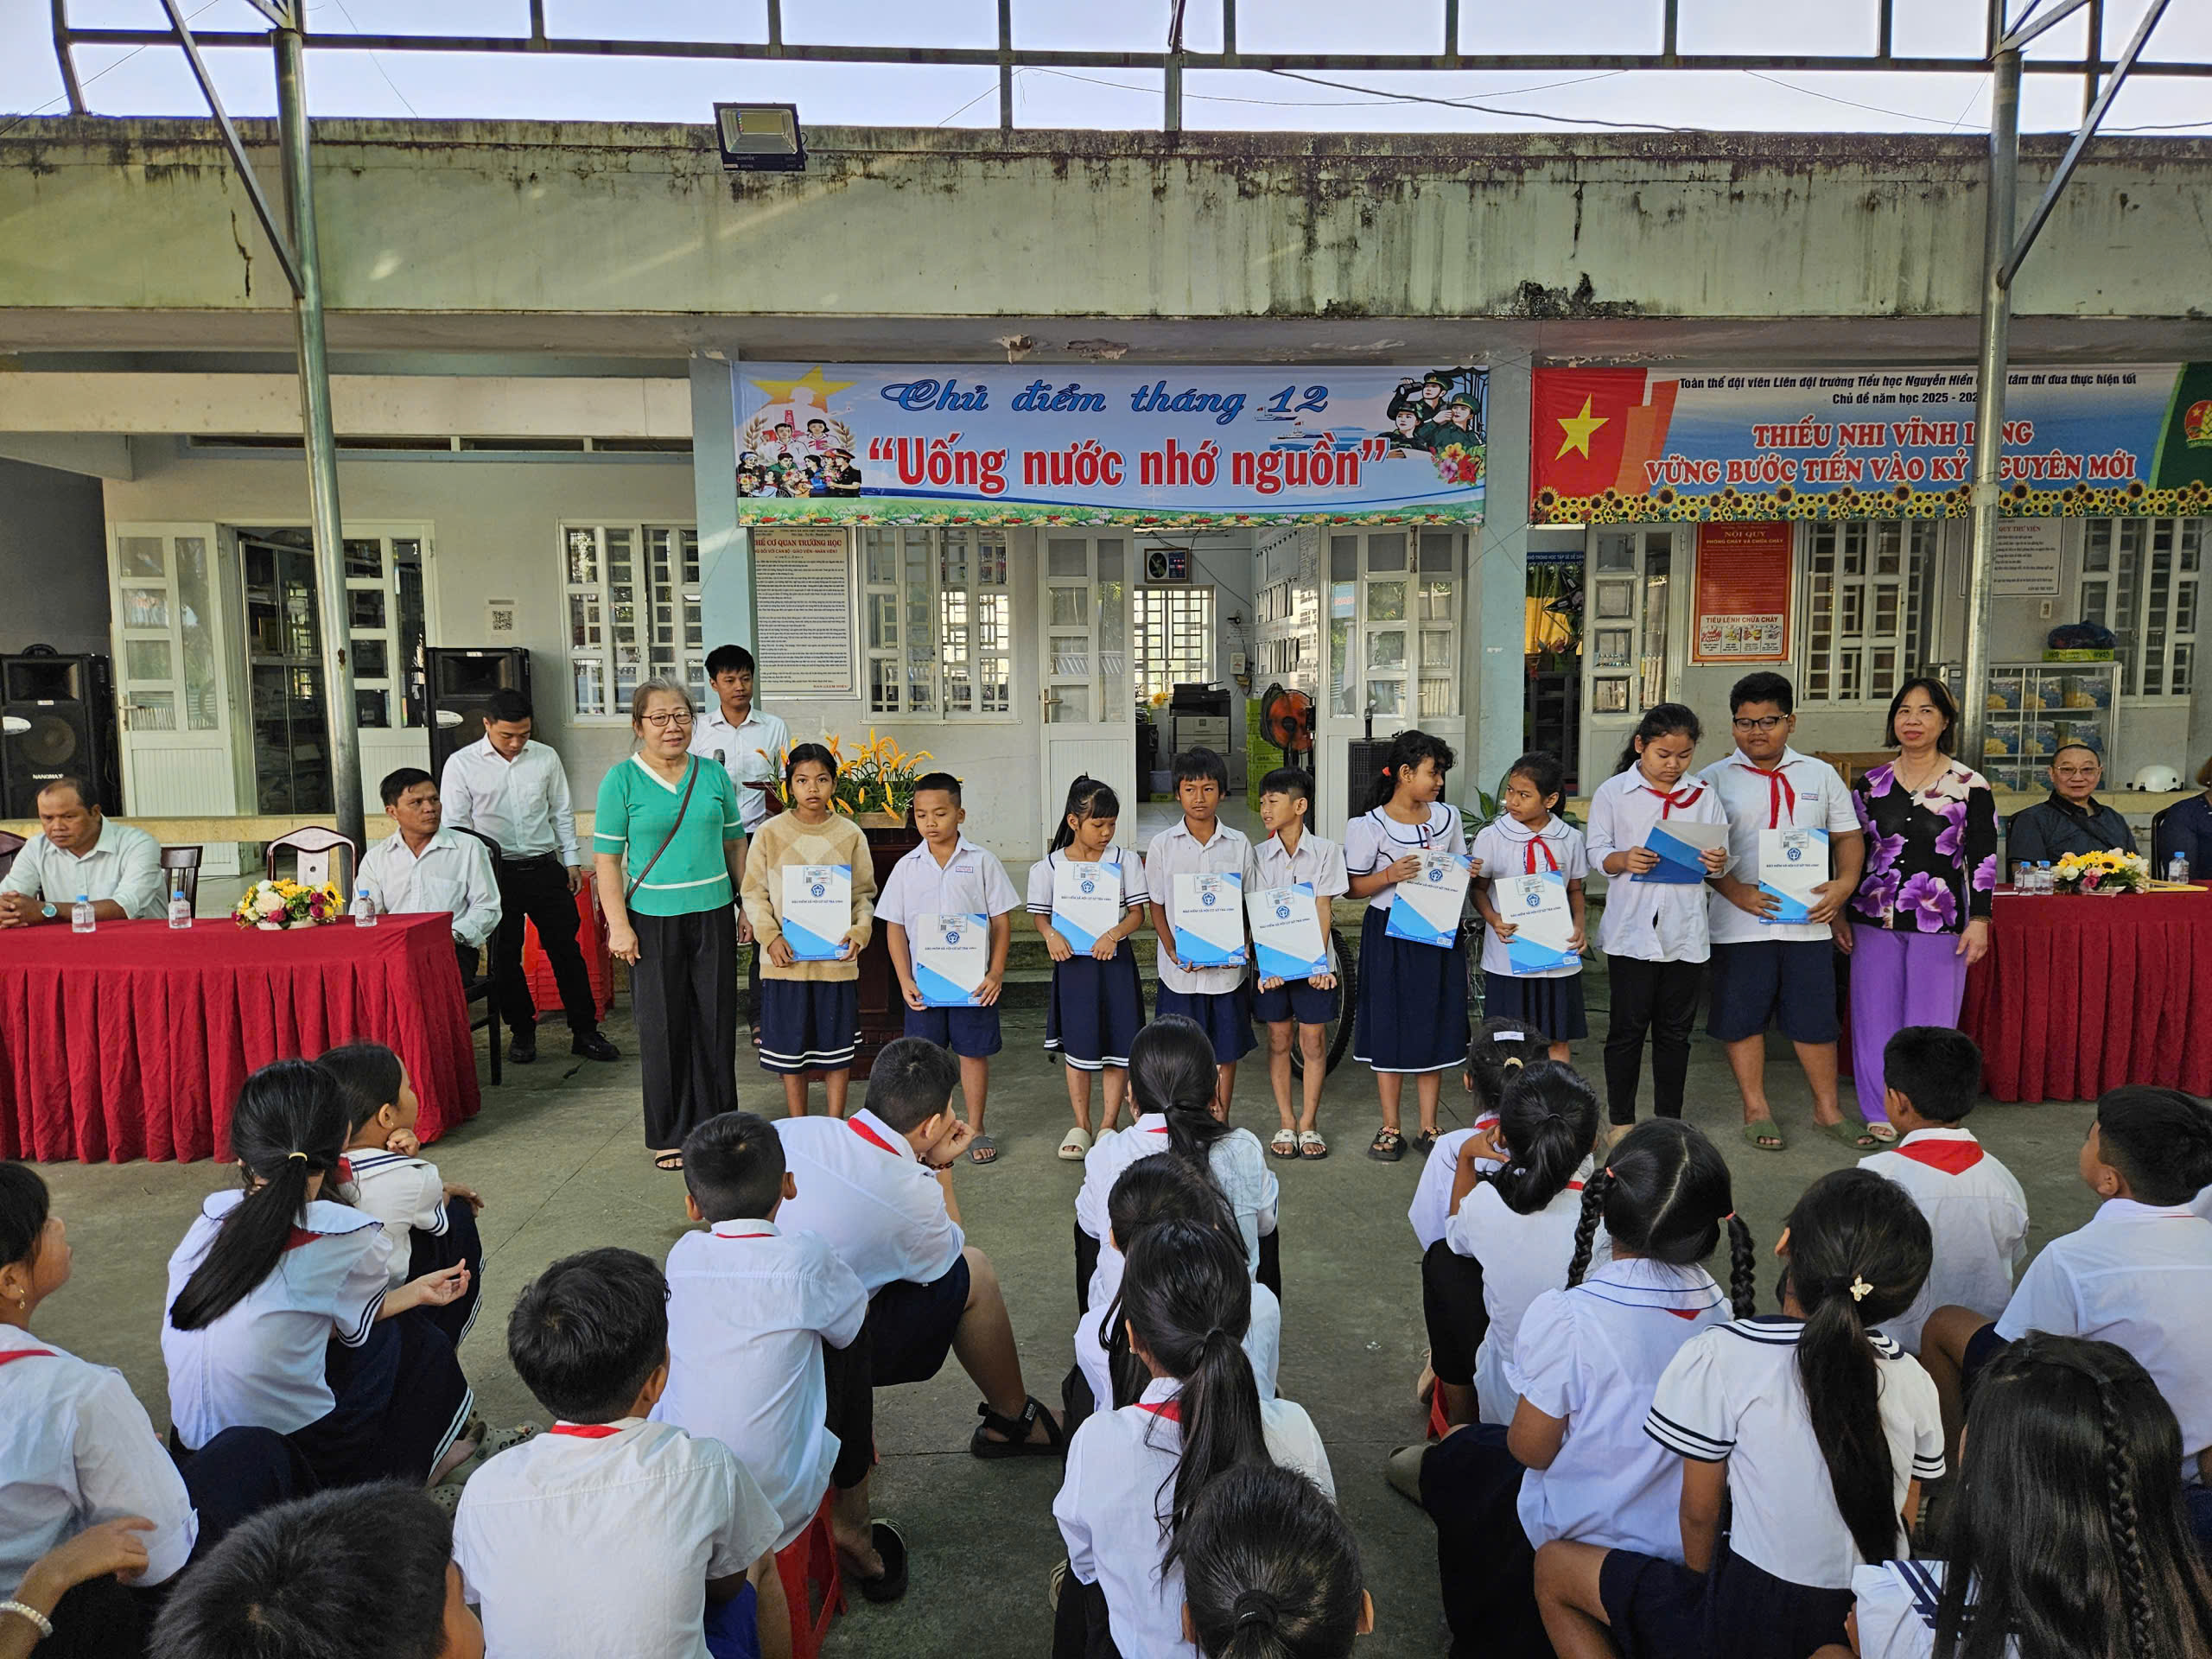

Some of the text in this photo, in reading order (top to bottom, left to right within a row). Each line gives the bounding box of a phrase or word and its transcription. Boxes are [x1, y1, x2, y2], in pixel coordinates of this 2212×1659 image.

[1680, 372, 2137, 391] Toàn thể đội viên Liên đội trường Tiểu học Nguyễn Hiền tâm thi đua thực hiện tốt
[1833, 392, 1853, 404] Chủ
[1856, 391, 1870, 404] đề
[1872, 393, 1896, 404] năm
[1899, 391, 1919, 404] học
[1922, 391, 1948, 404] 2025
[1959, 391, 1978, 403] 202
[880, 379, 1329, 425] Chủ điểm tháng 12
[1753, 415, 2033, 448] THIẾU NHI VĨNH LNG
[868, 431, 1387, 495] “Uống nước nhớ nguồn”
[1645, 448, 2137, 484] VỮNG BƯỚC TIẾN VÀO KỶ GUYÊN MỚI
[755, 537, 766, 546] HẾ
[798, 537, 825, 546] TRƯỜNG
